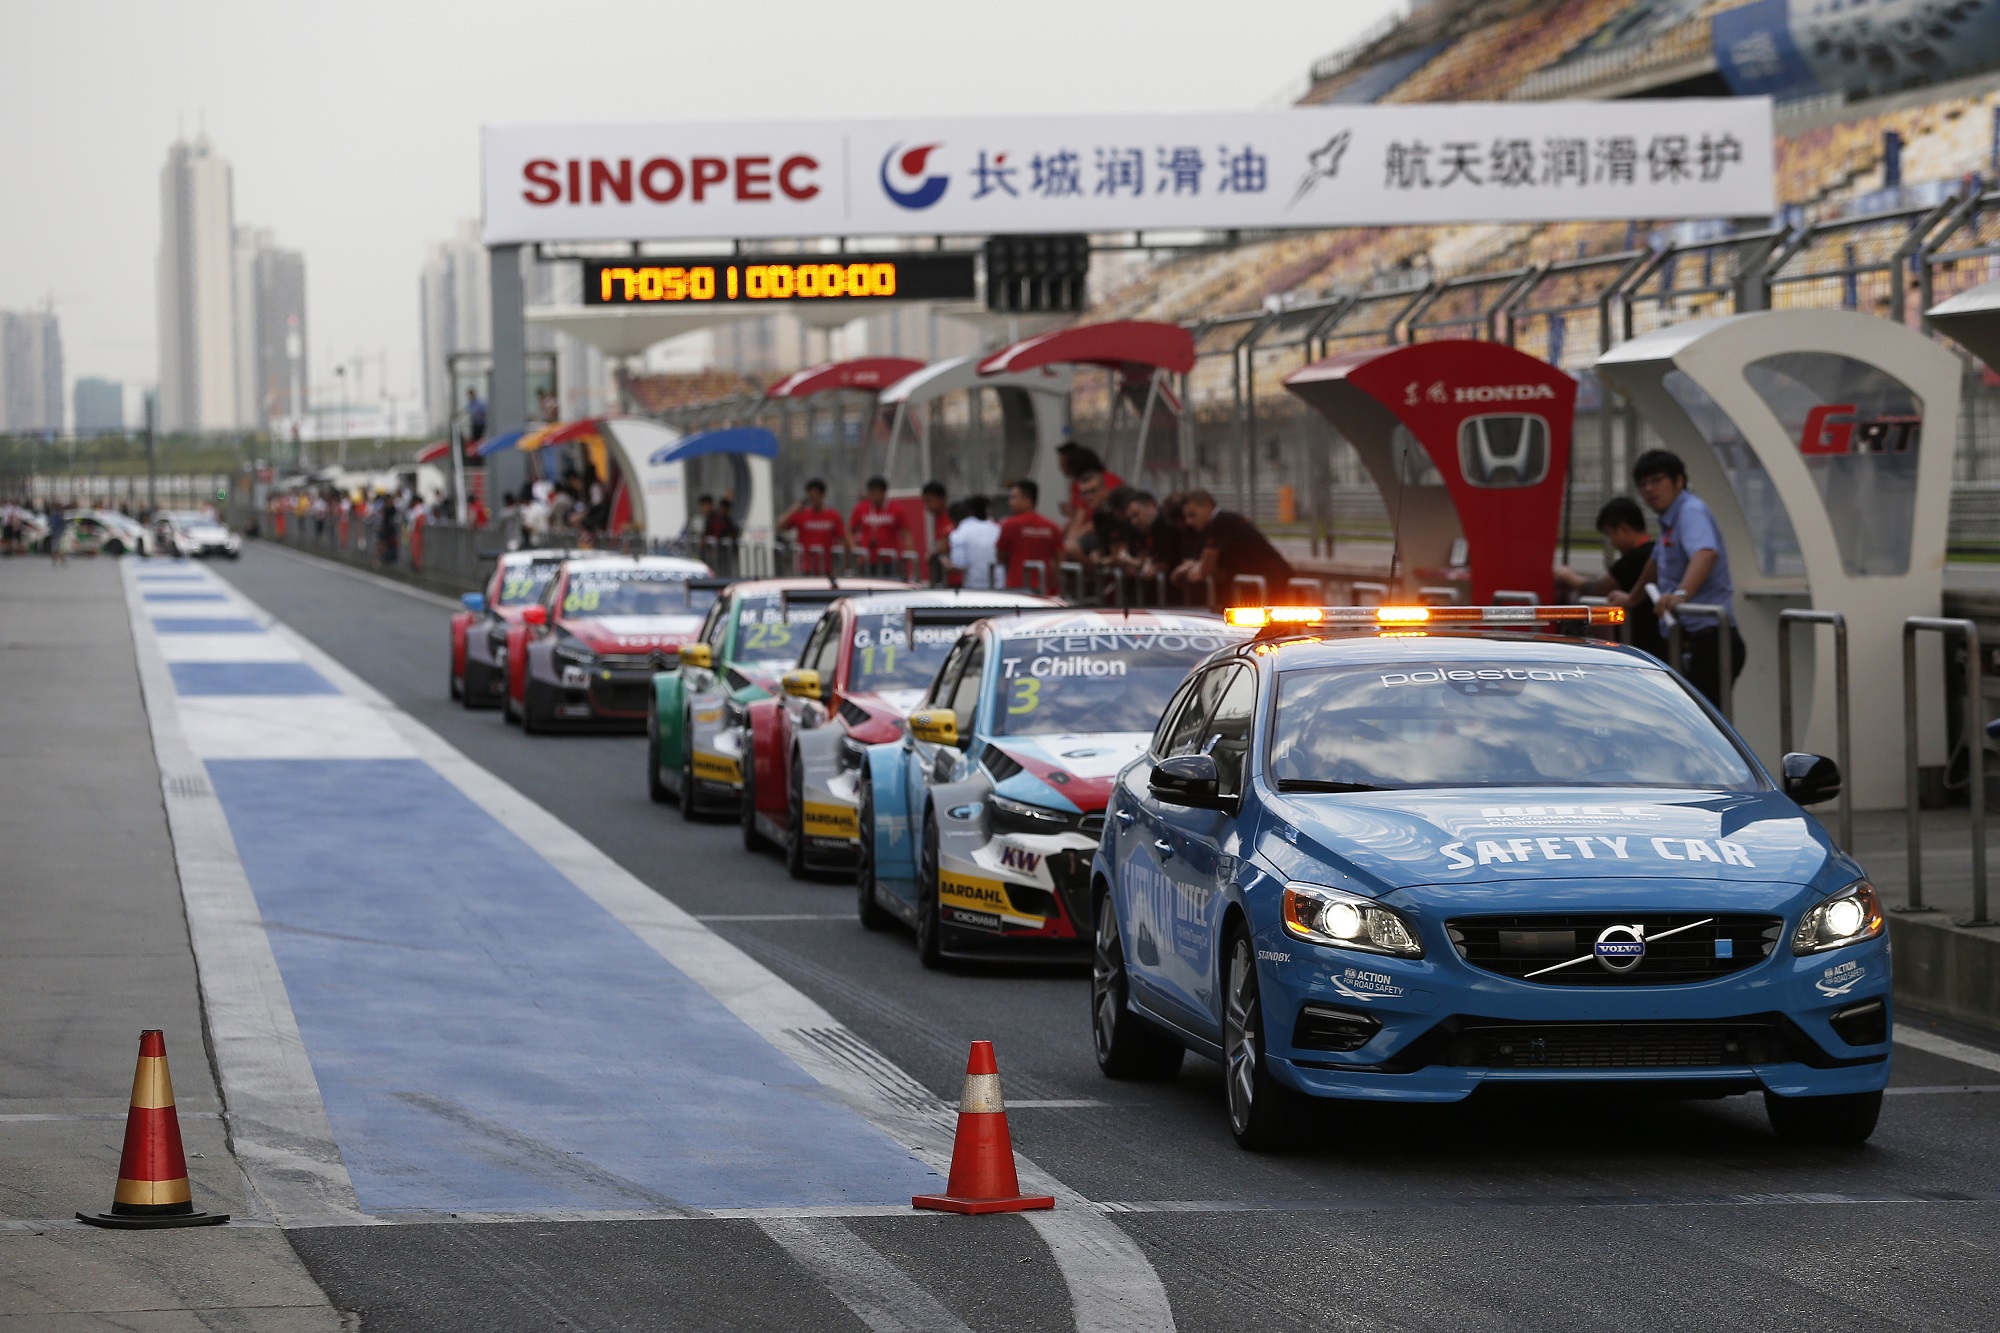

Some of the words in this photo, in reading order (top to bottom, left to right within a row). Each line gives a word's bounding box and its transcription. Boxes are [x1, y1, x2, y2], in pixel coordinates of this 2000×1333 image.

[970, 145, 1267, 198] 长城润滑油
[1383, 133, 1743, 189] 航天级润滑保护
[521, 155, 822, 206] SINOPEC
[1455, 383, 1555, 403] HONDA
[745, 623, 792, 649] 25
[854, 629, 875, 649] G.
[862, 645, 897, 675] 11
[1003, 657, 1021, 679] T.
[1031, 654, 1127, 677] Chilton
[1380, 667, 1590, 688] polestar
[1008, 678, 1041, 715] 3
[1000, 846, 1041, 873] KW
[1439, 836, 1629, 871] SAFETY
[1650, 837, 1756, 868] CAR
[941, 881, 1003, 904] BARDAHL
[953, 910, 999, 928] YOKOHAMA
[1598, 945, 1642, 953] VOLVO
[1357, 970, 1391, 985] ACTION
[1834, 960, 1856, 975] ACTION
[1343, 977, 1354, 985] FOR
[1353, 979, 1374, 990] ROAD
[1374, 983, 1404, 995] SAFETY
